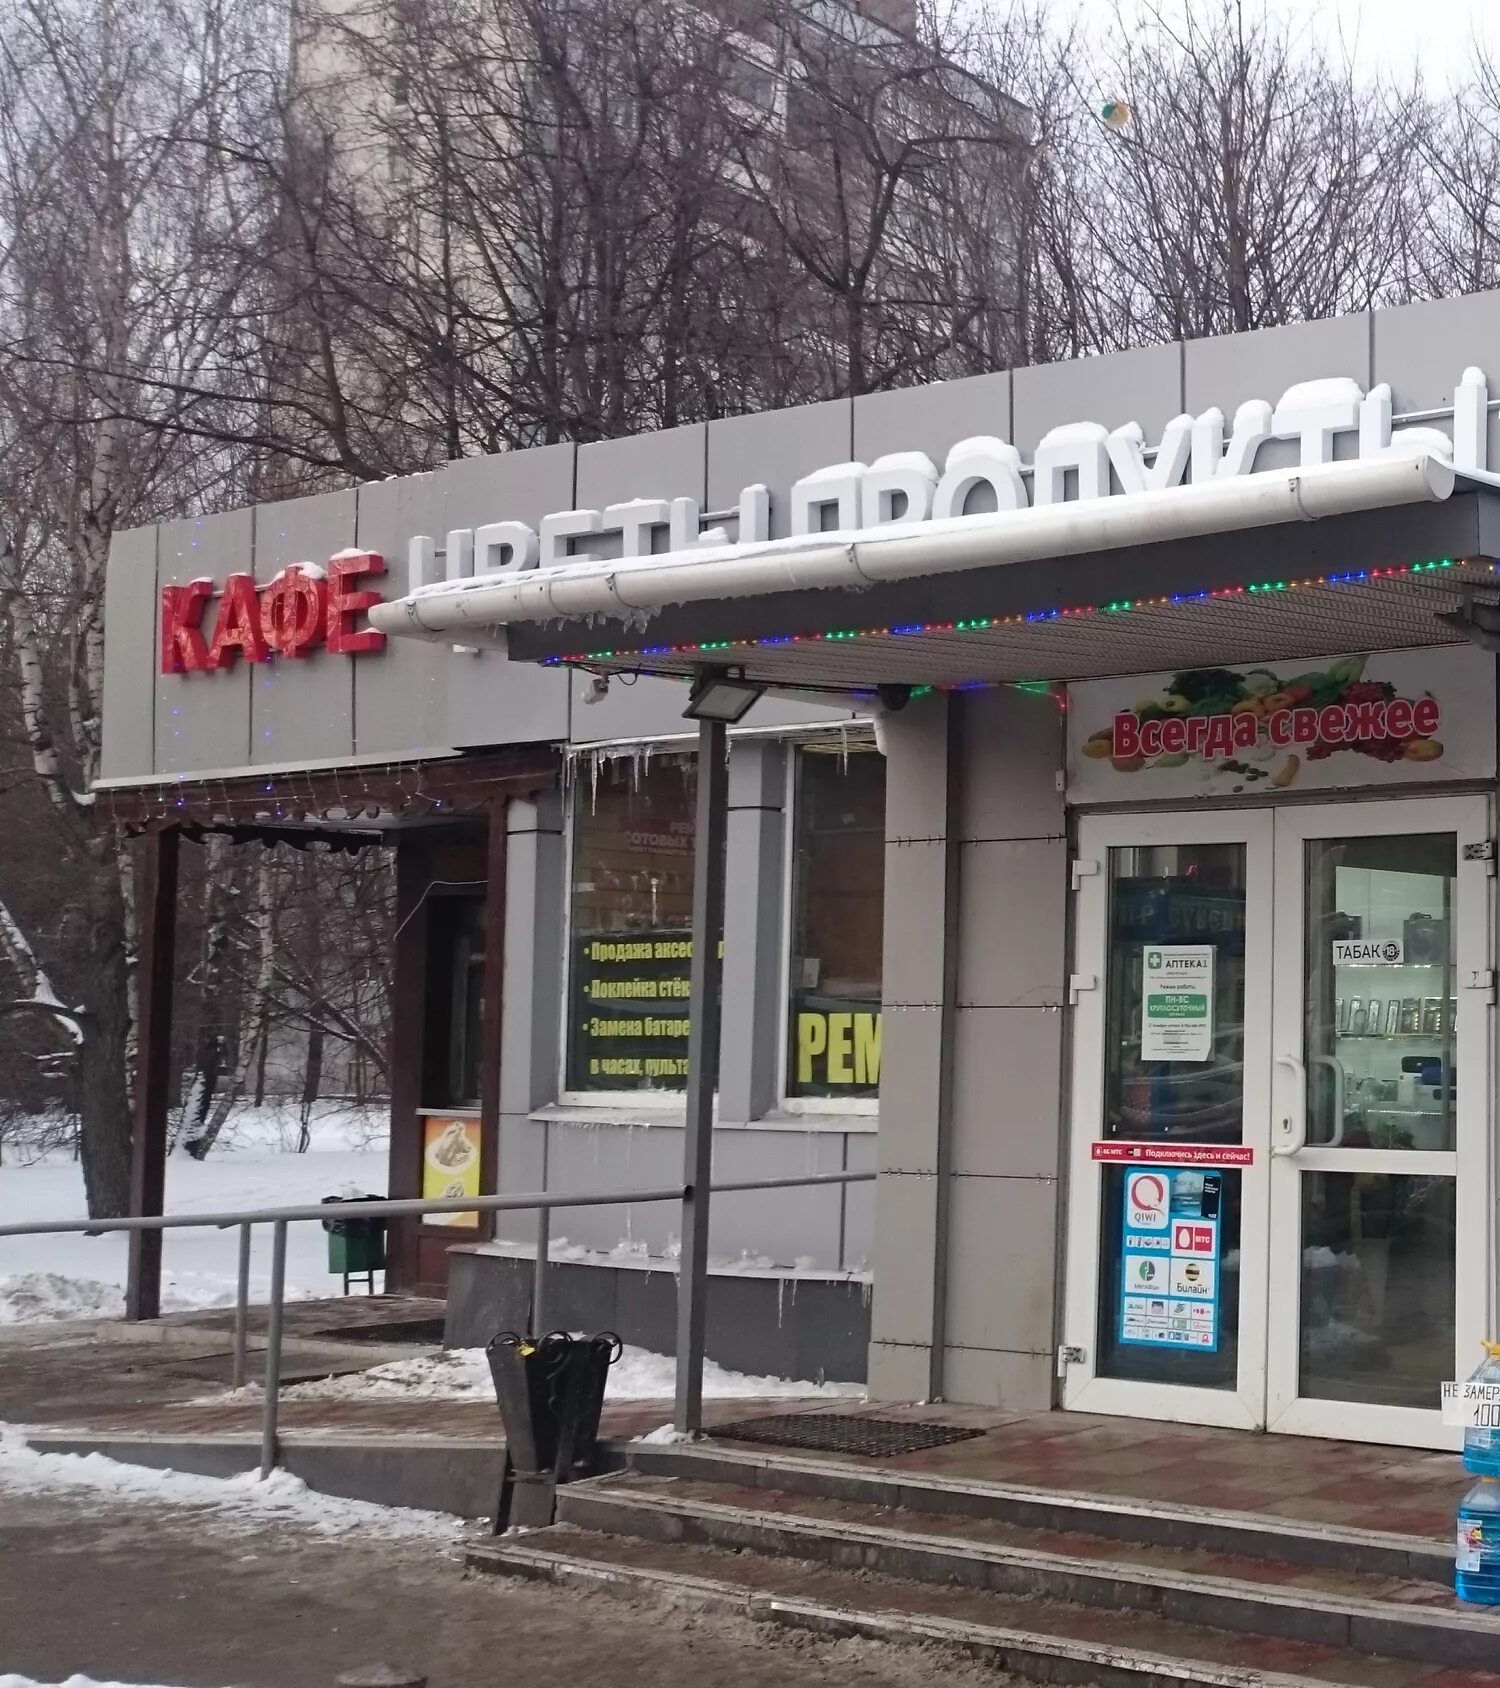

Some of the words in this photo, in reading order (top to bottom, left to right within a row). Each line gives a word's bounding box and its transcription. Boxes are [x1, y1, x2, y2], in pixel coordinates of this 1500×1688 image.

[162, 553, 386, 675] КАФЕ
[1112, 711, 1259, 760] Всегда
[1269, 699, 1441, 745] свежее
[591, 941, 653, 962] Продажа
[1336, 944, 1381, 960] ТАБАК
[591, 977, 657, 998] Поклейка
[590, 1017, 643, 1037] Замена
[590, 1059, 599, 1075] в
[1145, 1149, 1192, 1159] Подключись
[1194, 1150, 1214, 1160] здесь
[1222, 1151, 1250, 1161] сейчас!
[1135, 1212, 1156, 1222] QIWI
[1195, 1235, 1210, 1244] МТС
[1443, 1383, 1459, 1397] НЕ
[1473, 1403, 1500, 1427] 100
